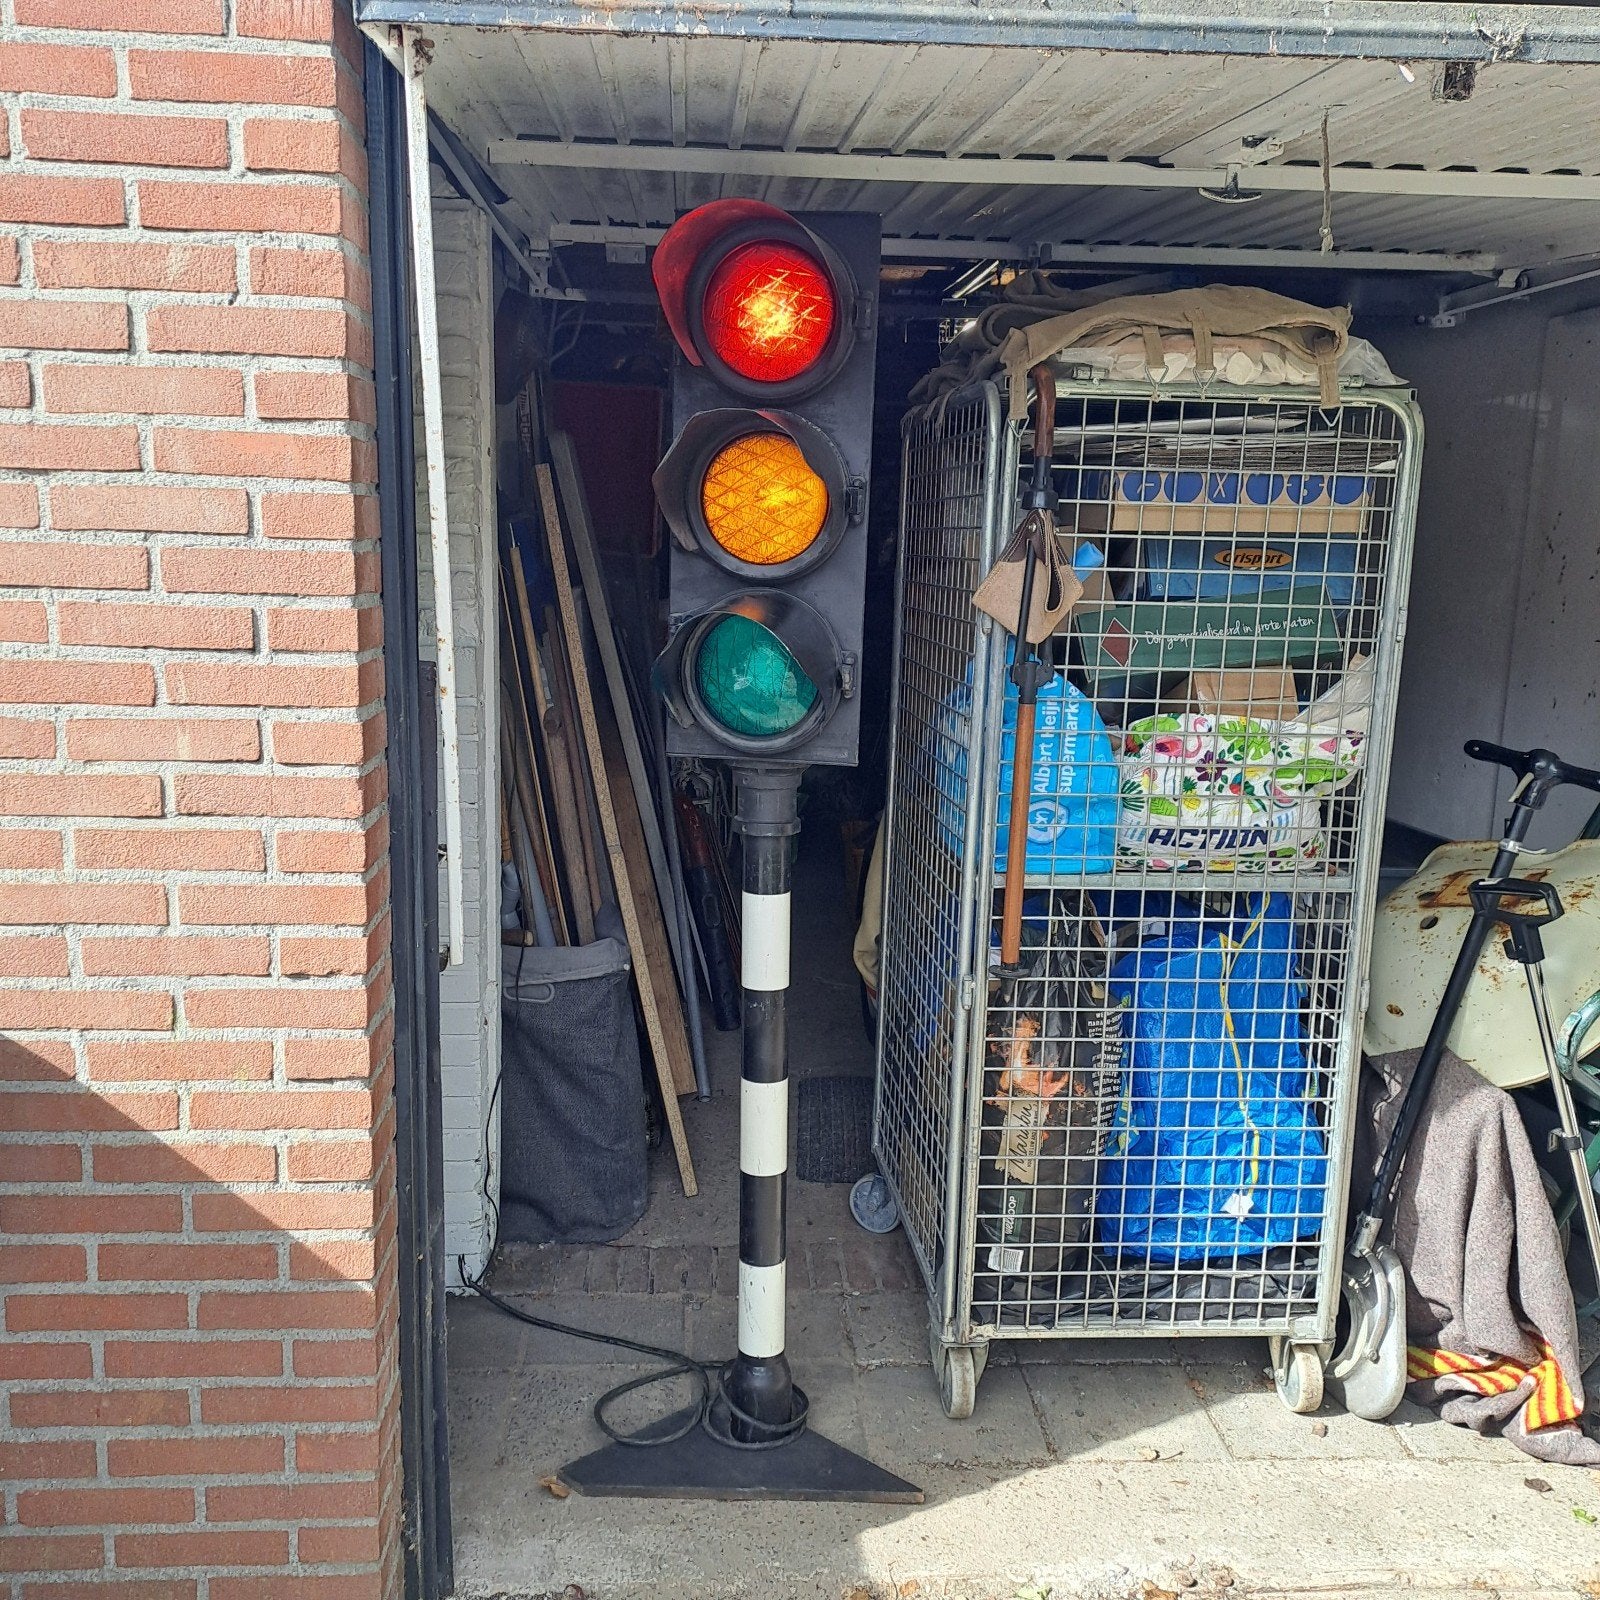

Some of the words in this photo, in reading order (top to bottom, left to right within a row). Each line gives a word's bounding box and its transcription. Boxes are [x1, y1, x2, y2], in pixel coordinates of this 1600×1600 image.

[1041, 694, 1061, 738] Heijn
[1034, 742, 1054, 794] Albert
[1148, 827, 1269, 850] ACTION
